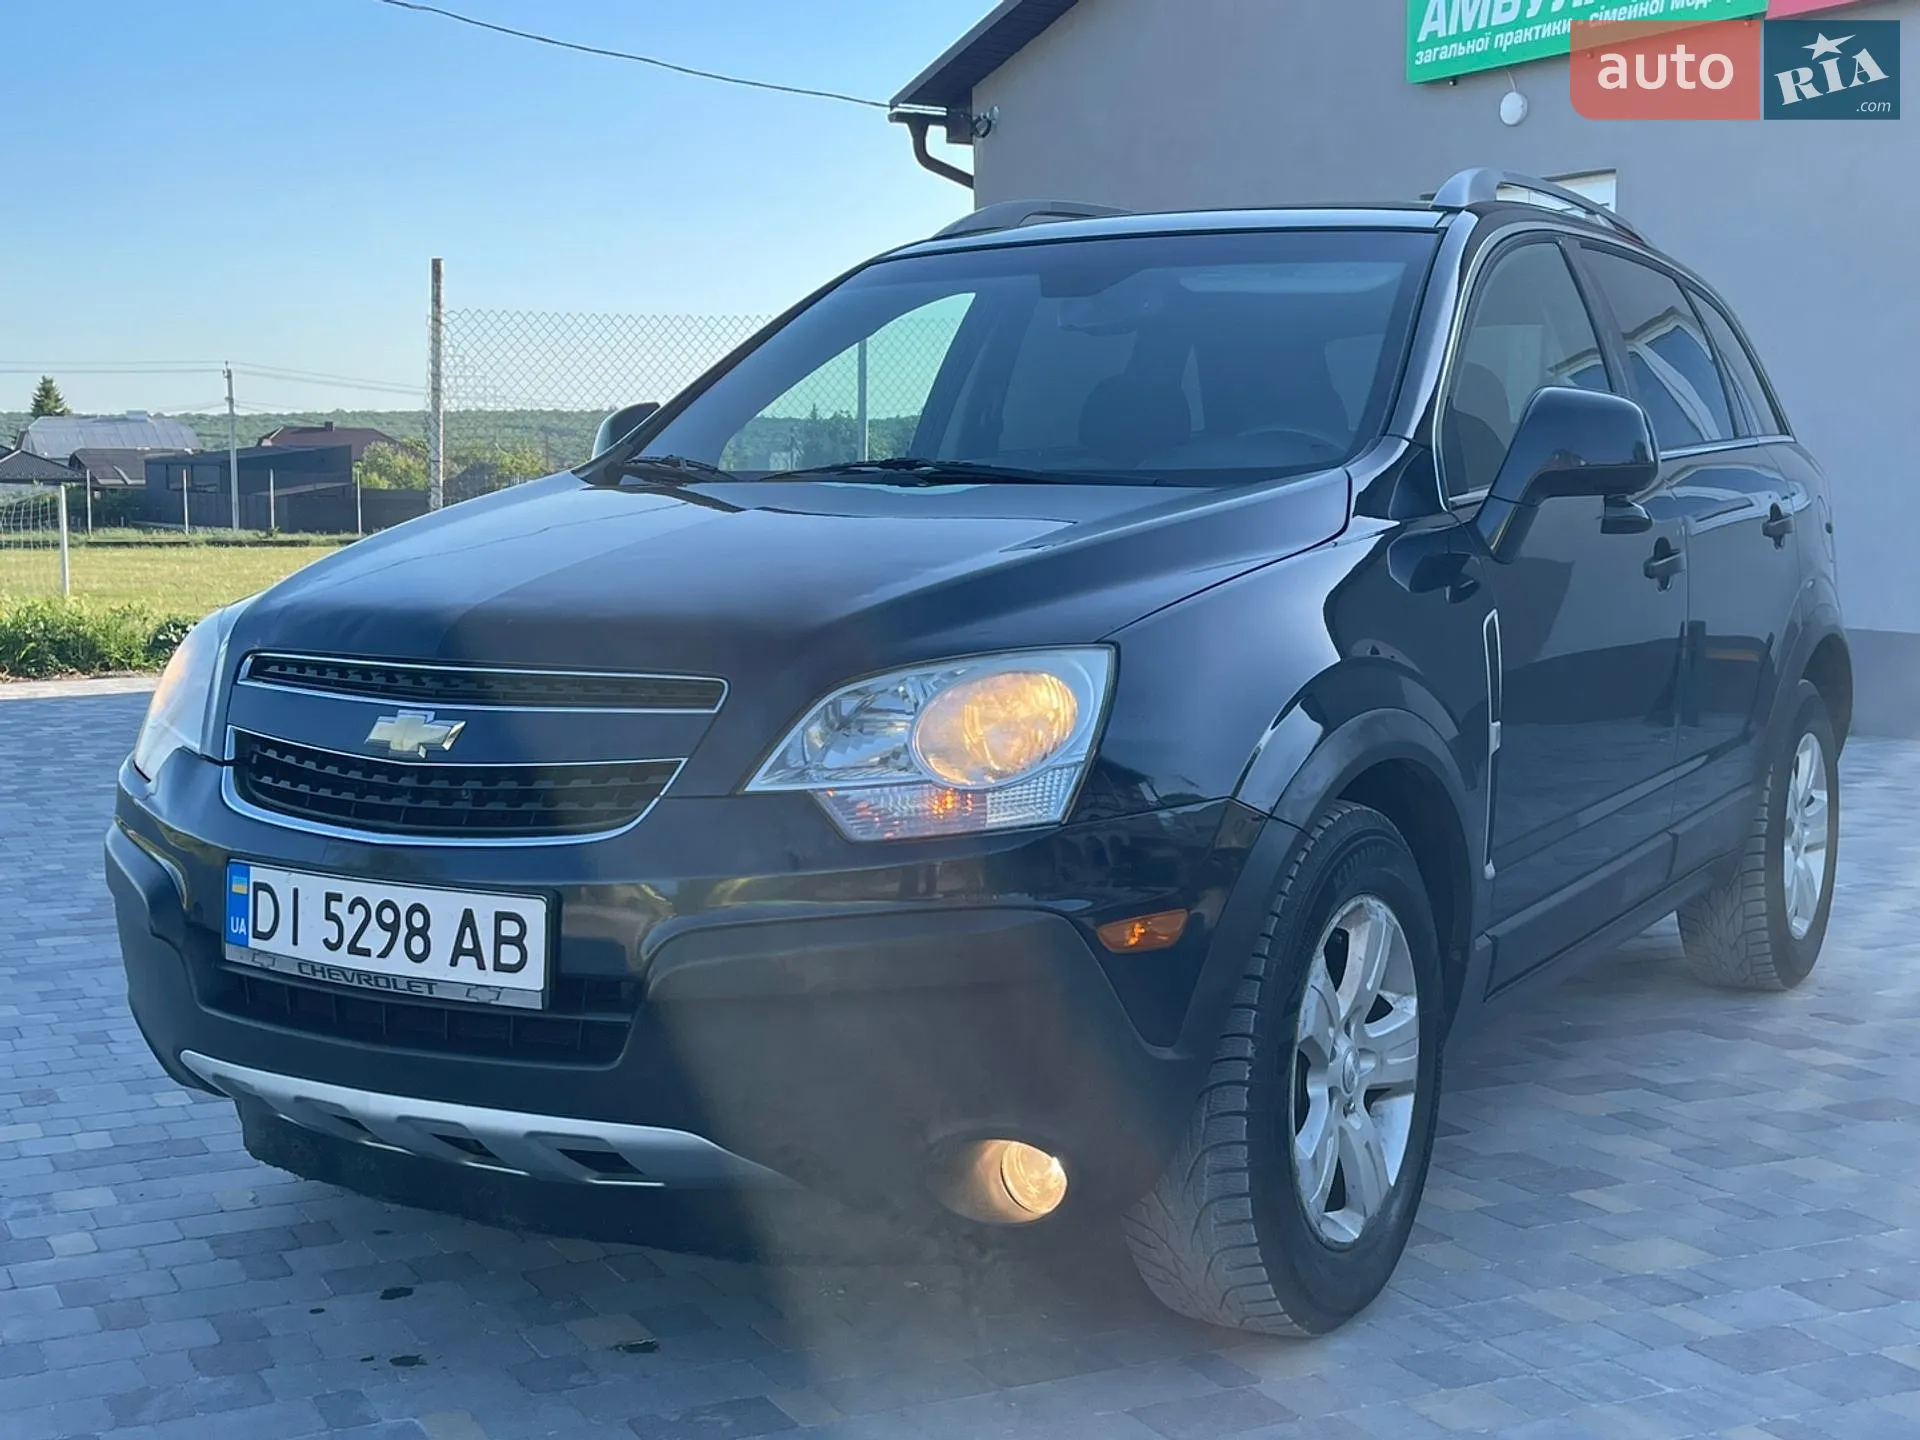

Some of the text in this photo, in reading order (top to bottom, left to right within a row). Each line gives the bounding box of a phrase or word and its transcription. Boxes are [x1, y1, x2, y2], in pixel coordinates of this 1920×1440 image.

[1415, 31, 1490, 65] загальної
[1494, 18, 1571, 52] практики
[230, 916, 247, 936] UA
[251, 880, 528, 974] DI 5298 AB
[298, 962, 438, 996] CHEVROLET
